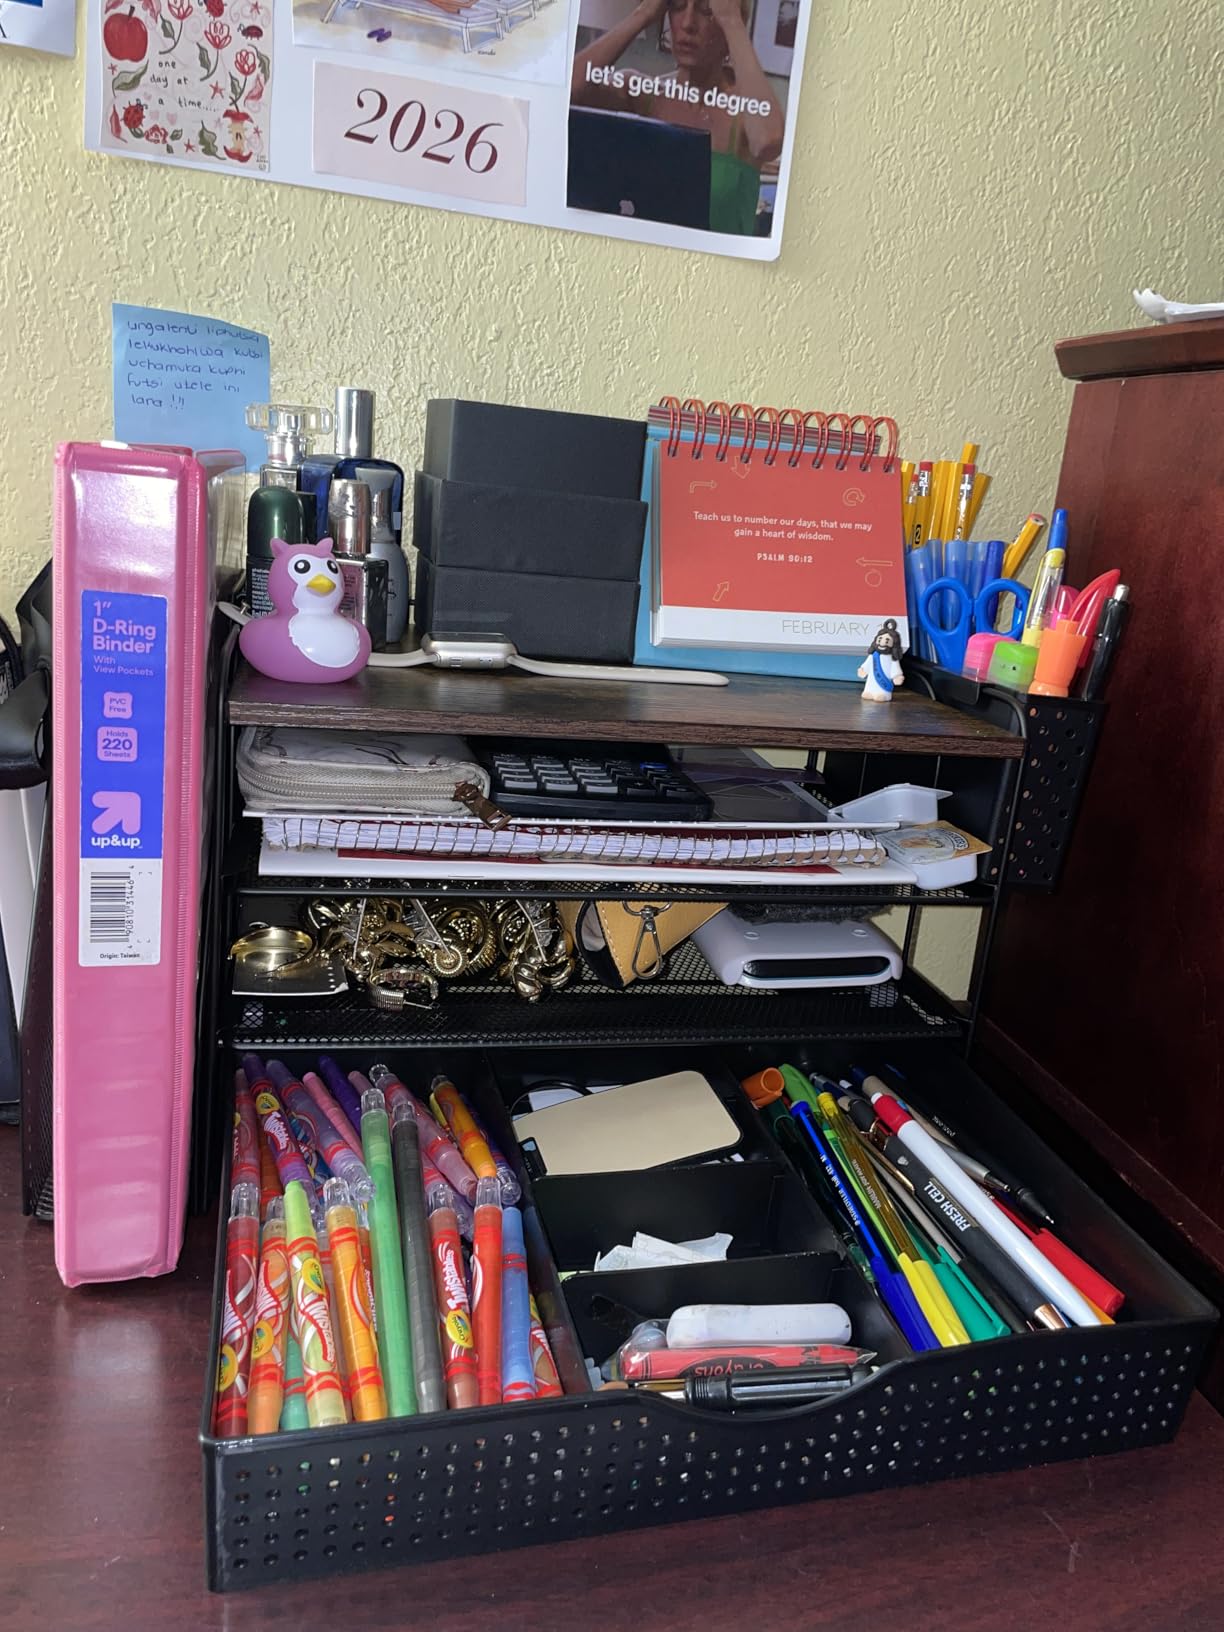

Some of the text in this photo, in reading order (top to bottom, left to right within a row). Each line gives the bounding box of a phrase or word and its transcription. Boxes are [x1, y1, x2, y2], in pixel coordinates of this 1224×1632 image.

[158, 61, 176, 69] one
[150, 75, 189, 87] day at
[586, 61, 771, 117] let's get this degree
[343, 88, 505, 174] 2026
[693, 511, 872, 532] Teach us to number our days, that we may
[734, 527, 753, 538] gain
[762, 528, 785, 538] heart
[786, 529, 796, 539] of
[797, 530, 834, 541] wisdom.
[757, 553, 813, 563] PSALM 90:12
[93, 619, 157, 640] D-Ring
[782, 619, 870, 637] FEBRUARY
[93, 636, 154, 653] Binder
[93, 655, 116, 665] With
[93, 665, 154, 677] View Pockets
[106, 730, 129, 738] Holds
[102, 738, 133, 750] 220
[103, 750, 131, 758] Sheets
[91, 834, 141, 849] up&up
[923, 1181, 971, 1232] FRESH CELL
